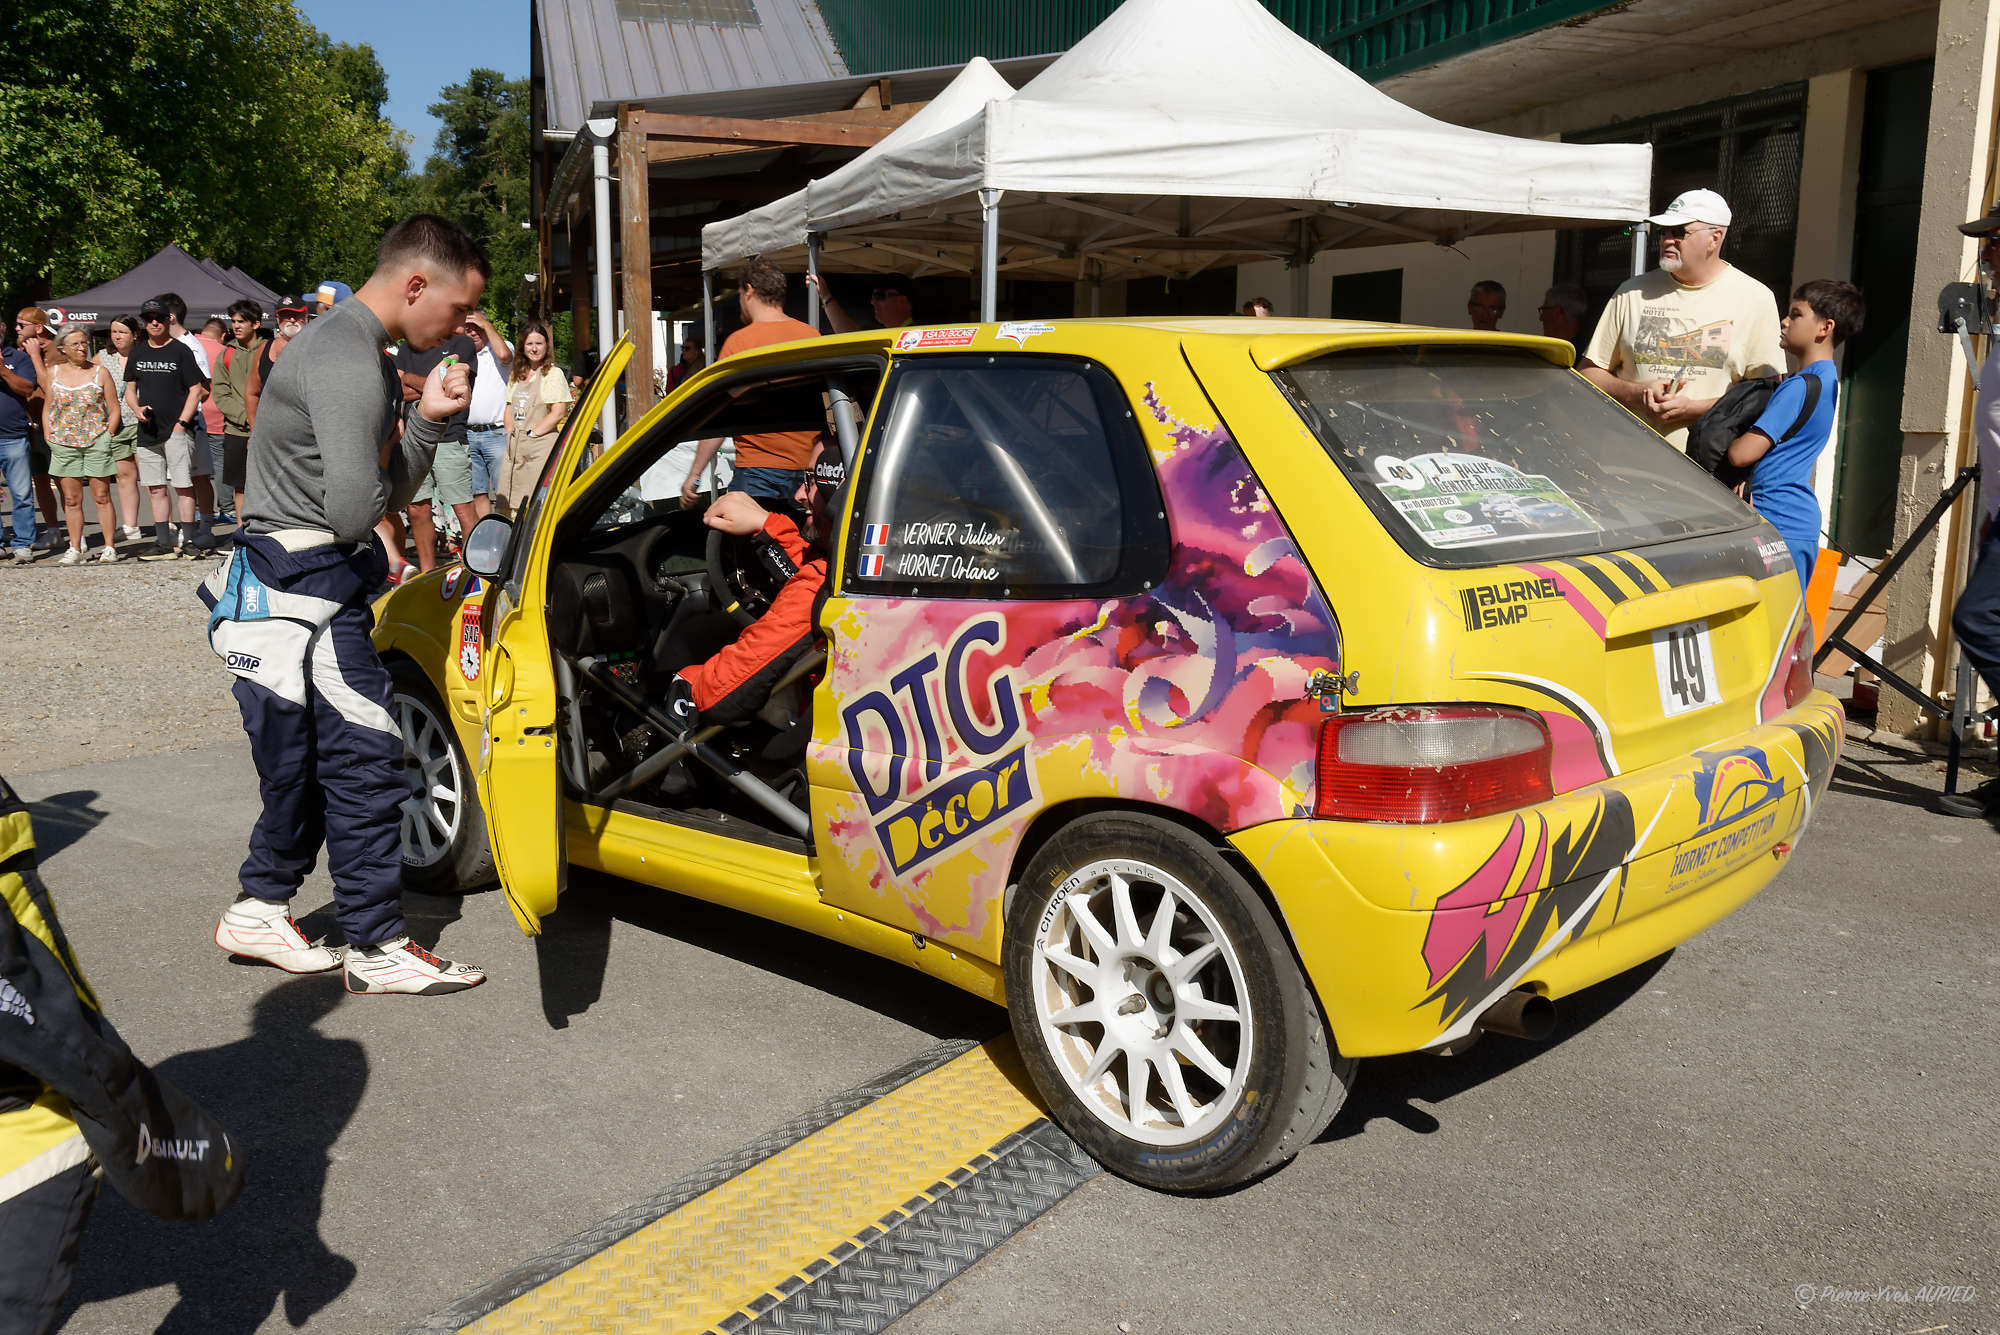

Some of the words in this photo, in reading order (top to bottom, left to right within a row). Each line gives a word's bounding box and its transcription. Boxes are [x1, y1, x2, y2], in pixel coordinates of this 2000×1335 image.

[136, 361, 177, 370] SIMMS
[1452, 462, 1496, 479] RALLYE
[903, 522, 957, 546] VERNIER
[959, 522, 1006, 546] Julien
[898, 553, 954, 578] HORNET
[951, 555, 1000, 581] Orlane
[246, 586, 258, 613] OMP
[1476, 578, 1566, 607] BURNEL
[1483, 605, 1528, 629] SMP
[227, 654, 260, 670] OMP
[1669, 626, 1706, 706] 49
[1670, 840, 1718, 878] HORNET
[1715, 810, 1776, 859] COMPETITION
[1090, 866, 1154, 880] RACING
[1041, 876, 1081, 933] CITROËN
